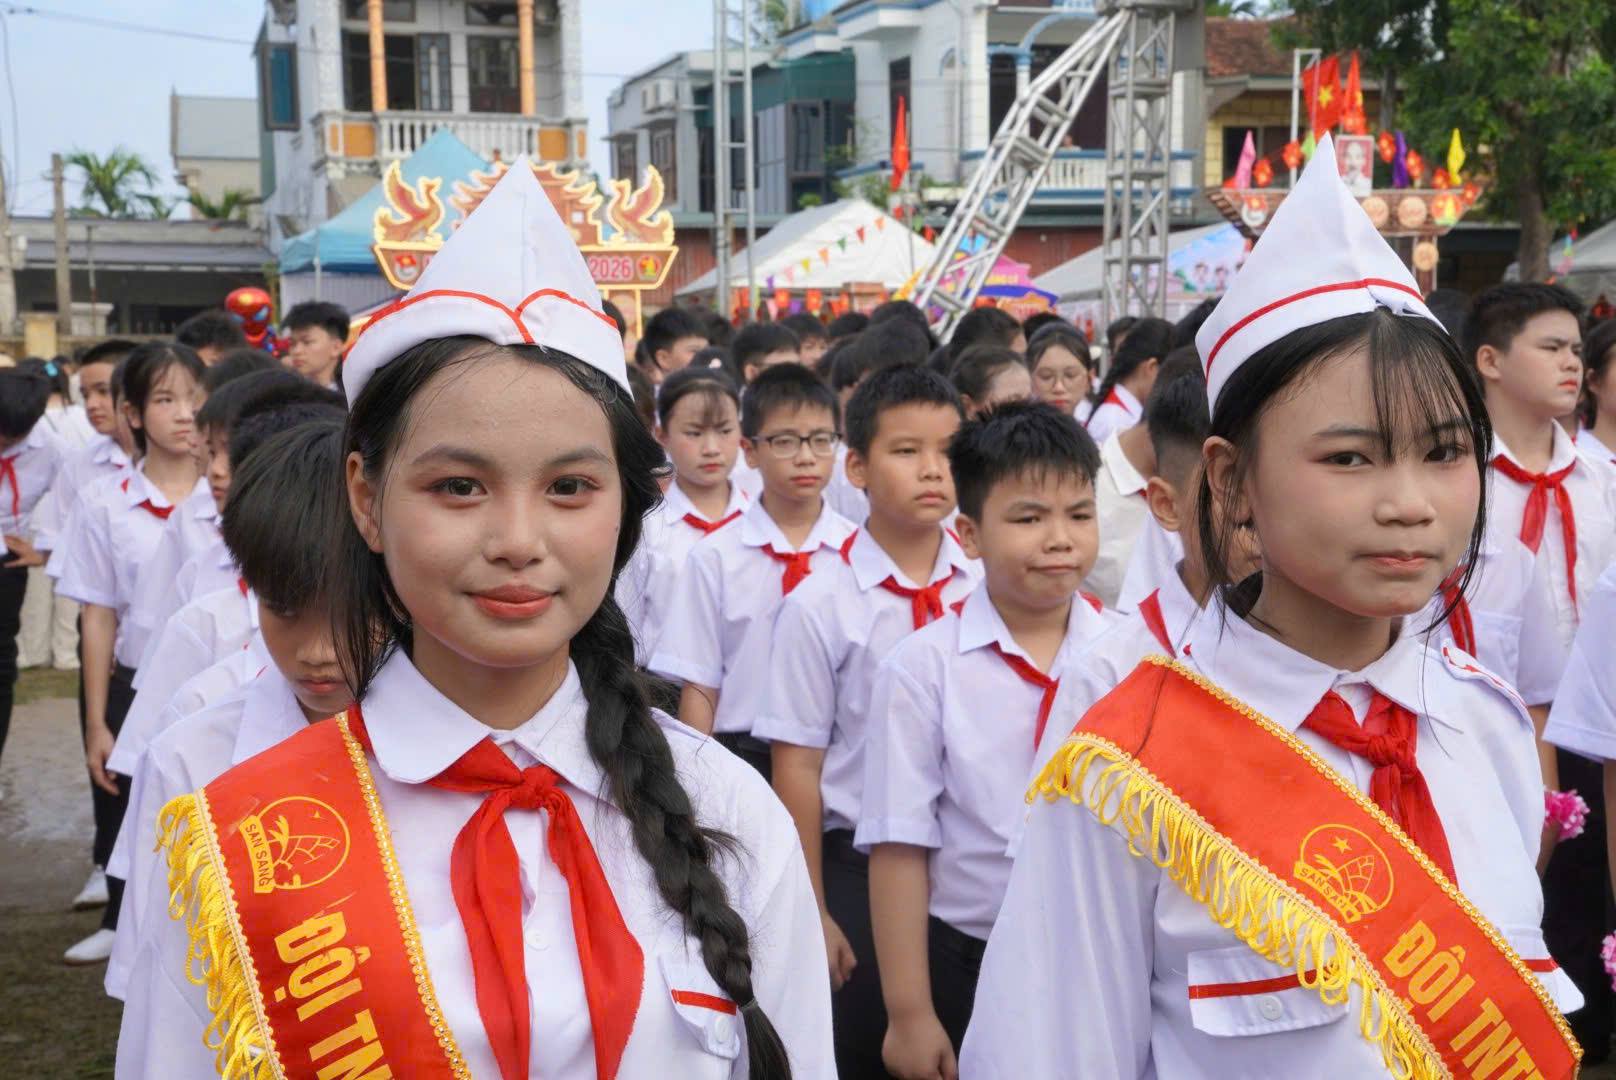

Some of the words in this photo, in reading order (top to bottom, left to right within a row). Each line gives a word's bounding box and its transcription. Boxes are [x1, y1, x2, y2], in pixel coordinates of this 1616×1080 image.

[590, 256, 632, 279] 2026
[274, 911, 371, 1022] ĐỘI
[1449, 997, 1545, 1080] TNT
